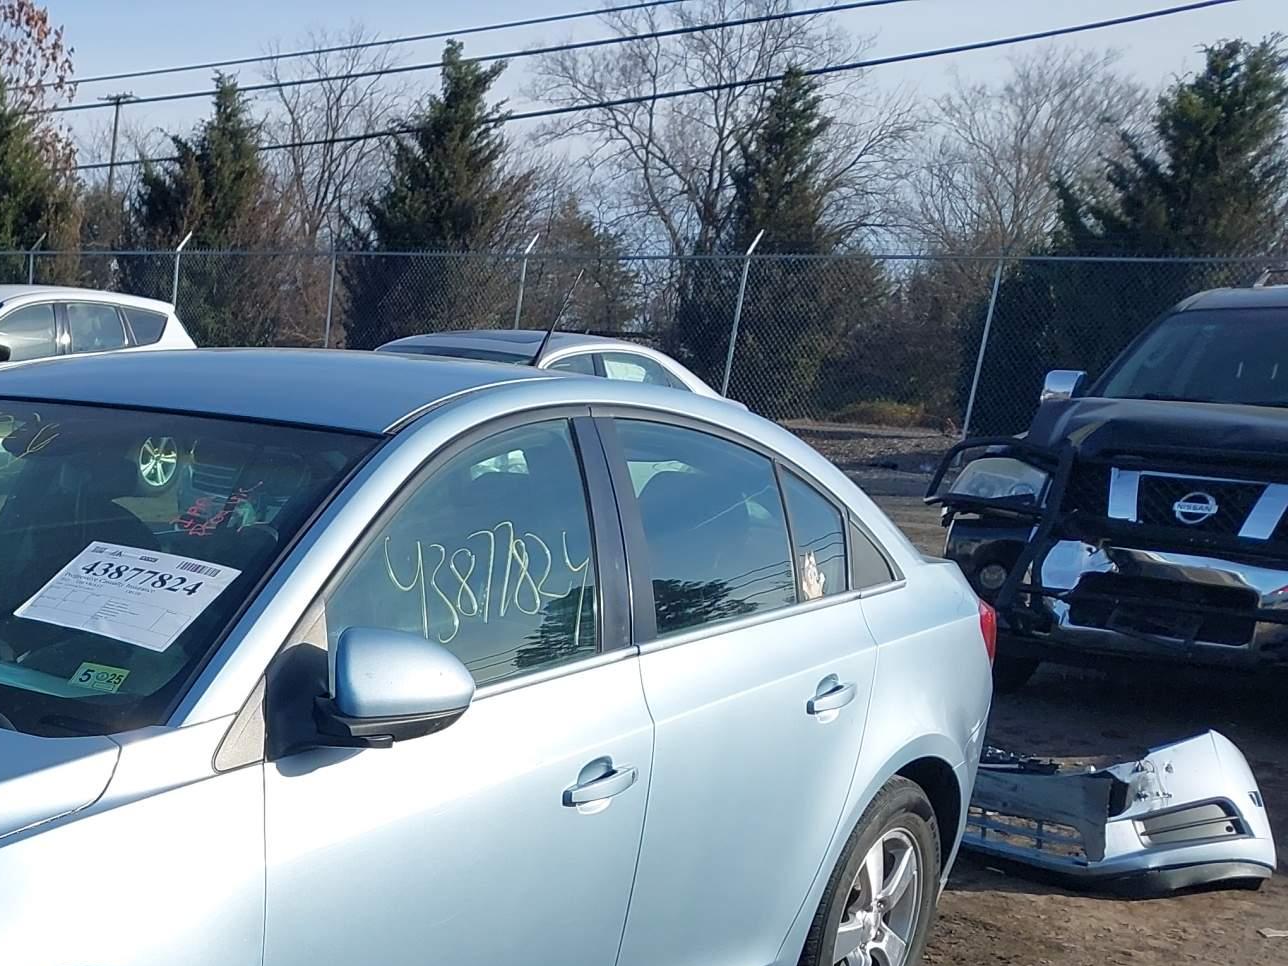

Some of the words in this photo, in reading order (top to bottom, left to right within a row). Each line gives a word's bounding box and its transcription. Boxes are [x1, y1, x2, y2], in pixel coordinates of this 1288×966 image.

[1177, 503, 1212, 512] NISSAN
[81, 560, 204, 596] 43877824
[78, 668, 95, 683] 5
[106, 673, 124, 685] 25
